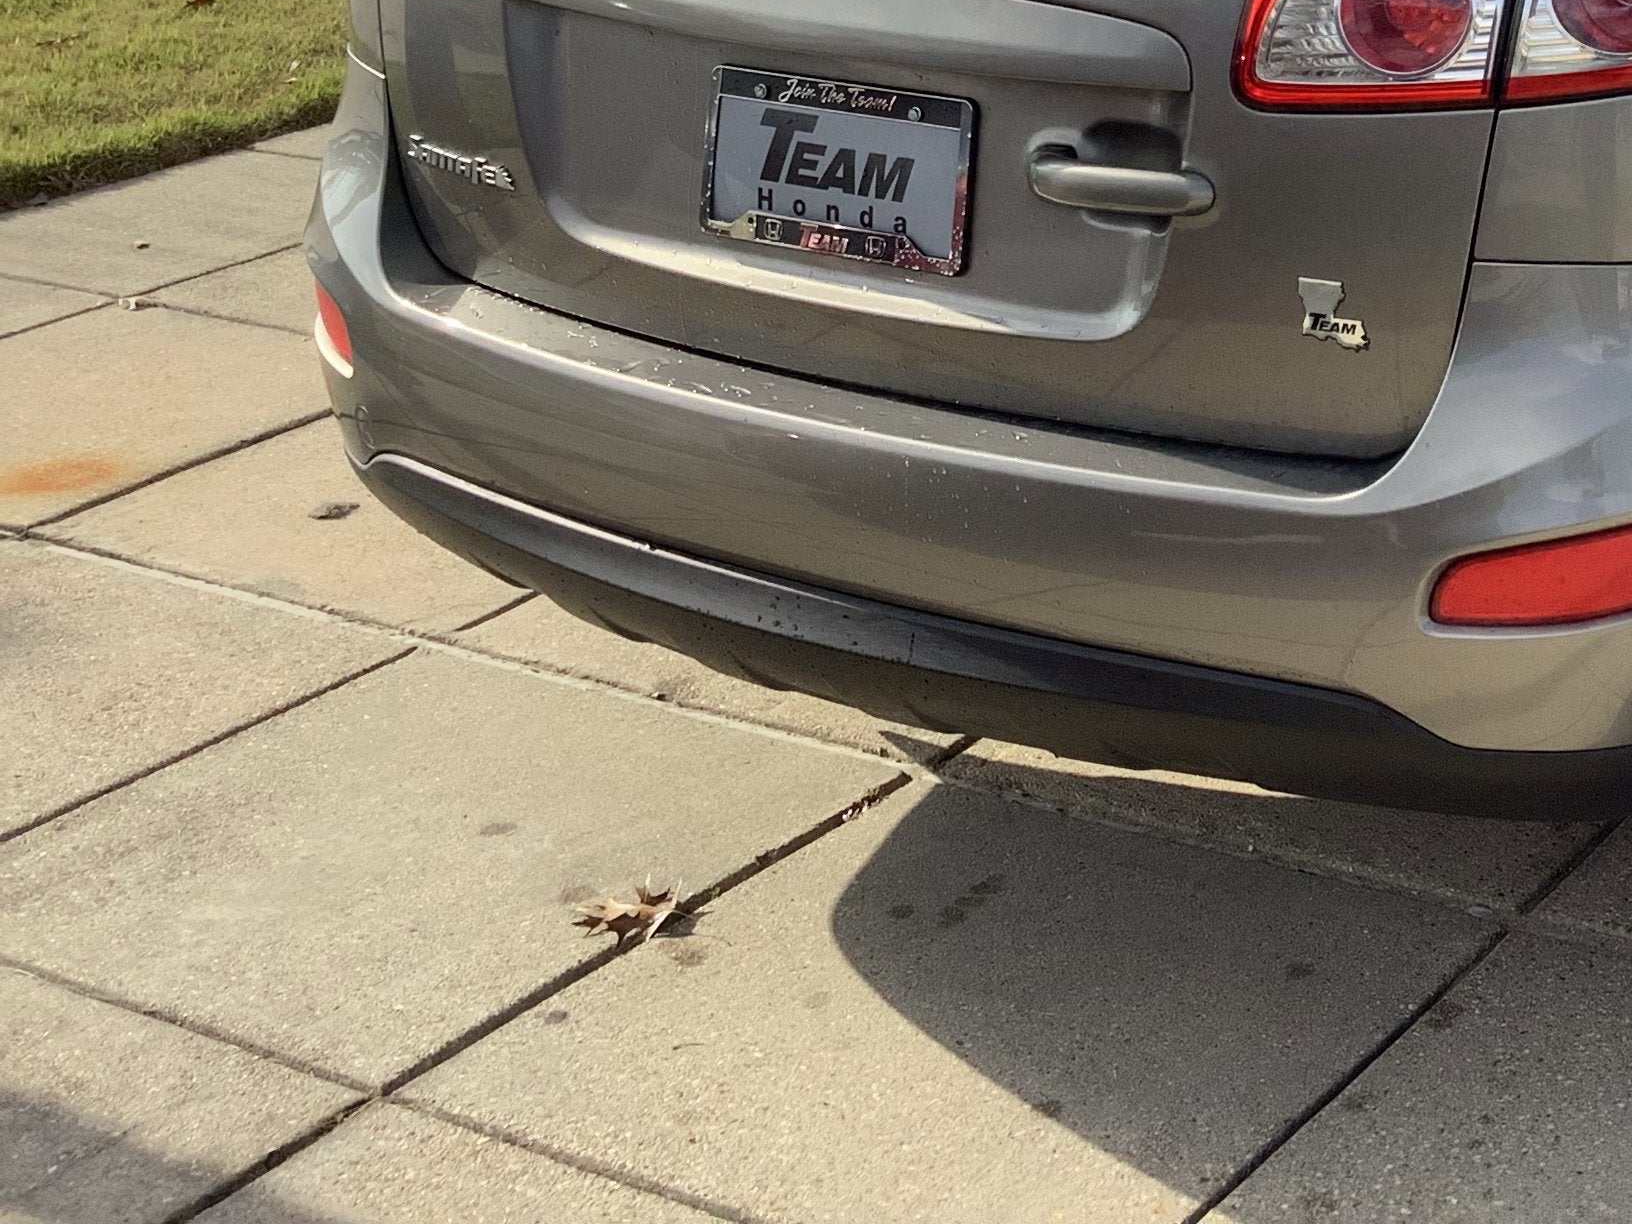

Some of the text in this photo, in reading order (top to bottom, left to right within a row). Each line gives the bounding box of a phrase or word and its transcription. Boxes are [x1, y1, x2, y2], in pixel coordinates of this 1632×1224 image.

[777, 78, 898, 112] Join The Team!
[760, 108, 915, 203] TEAM
[757, 187, 907, 235] Honda
[800, 222, 849, 254] TEAM
[1308, 312, 1357, 335] TEAM
